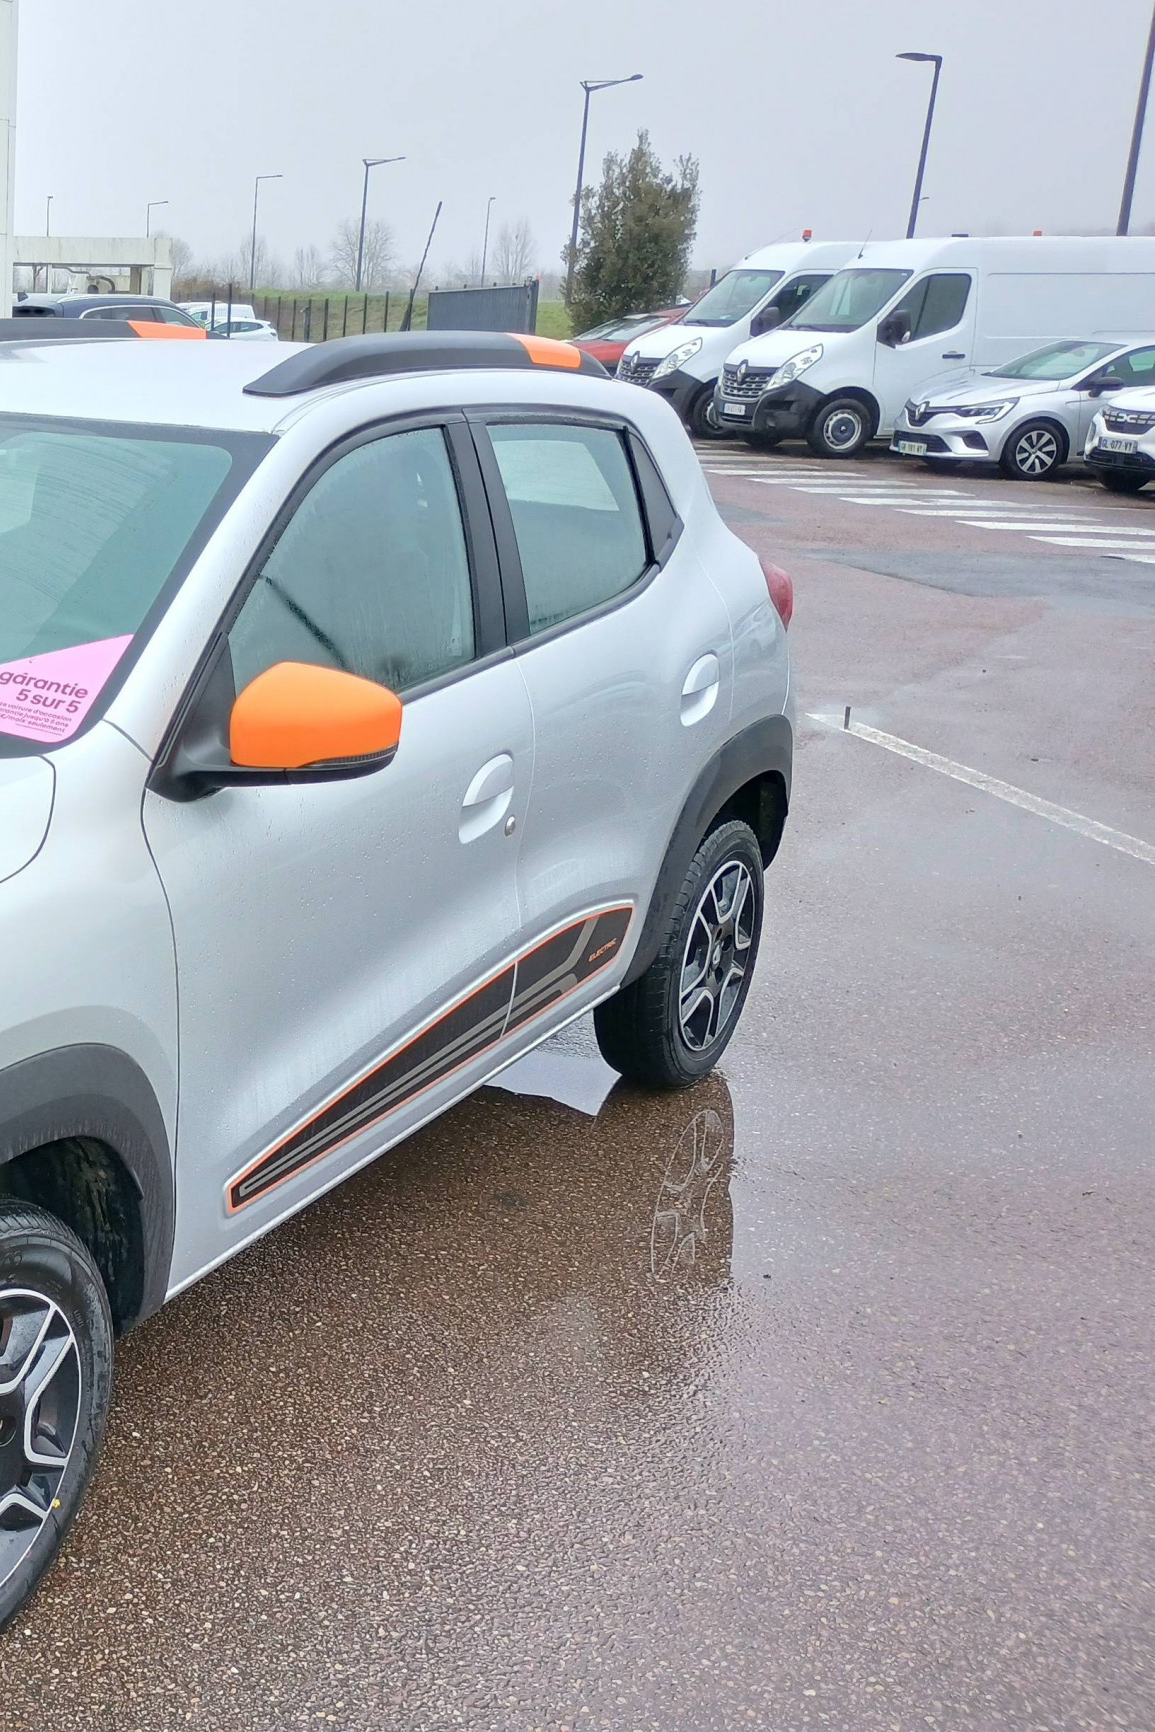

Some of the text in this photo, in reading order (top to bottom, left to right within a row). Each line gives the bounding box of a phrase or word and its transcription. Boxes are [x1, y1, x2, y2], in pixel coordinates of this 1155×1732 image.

[15, 688, 82, 714] 5 sur 5
[7, 702, 33, 713] voiture
[33, 709, 72, 722] d'occasion
[27, 719, 66, 733] seulement
[54, 719, 69, 728] ans
